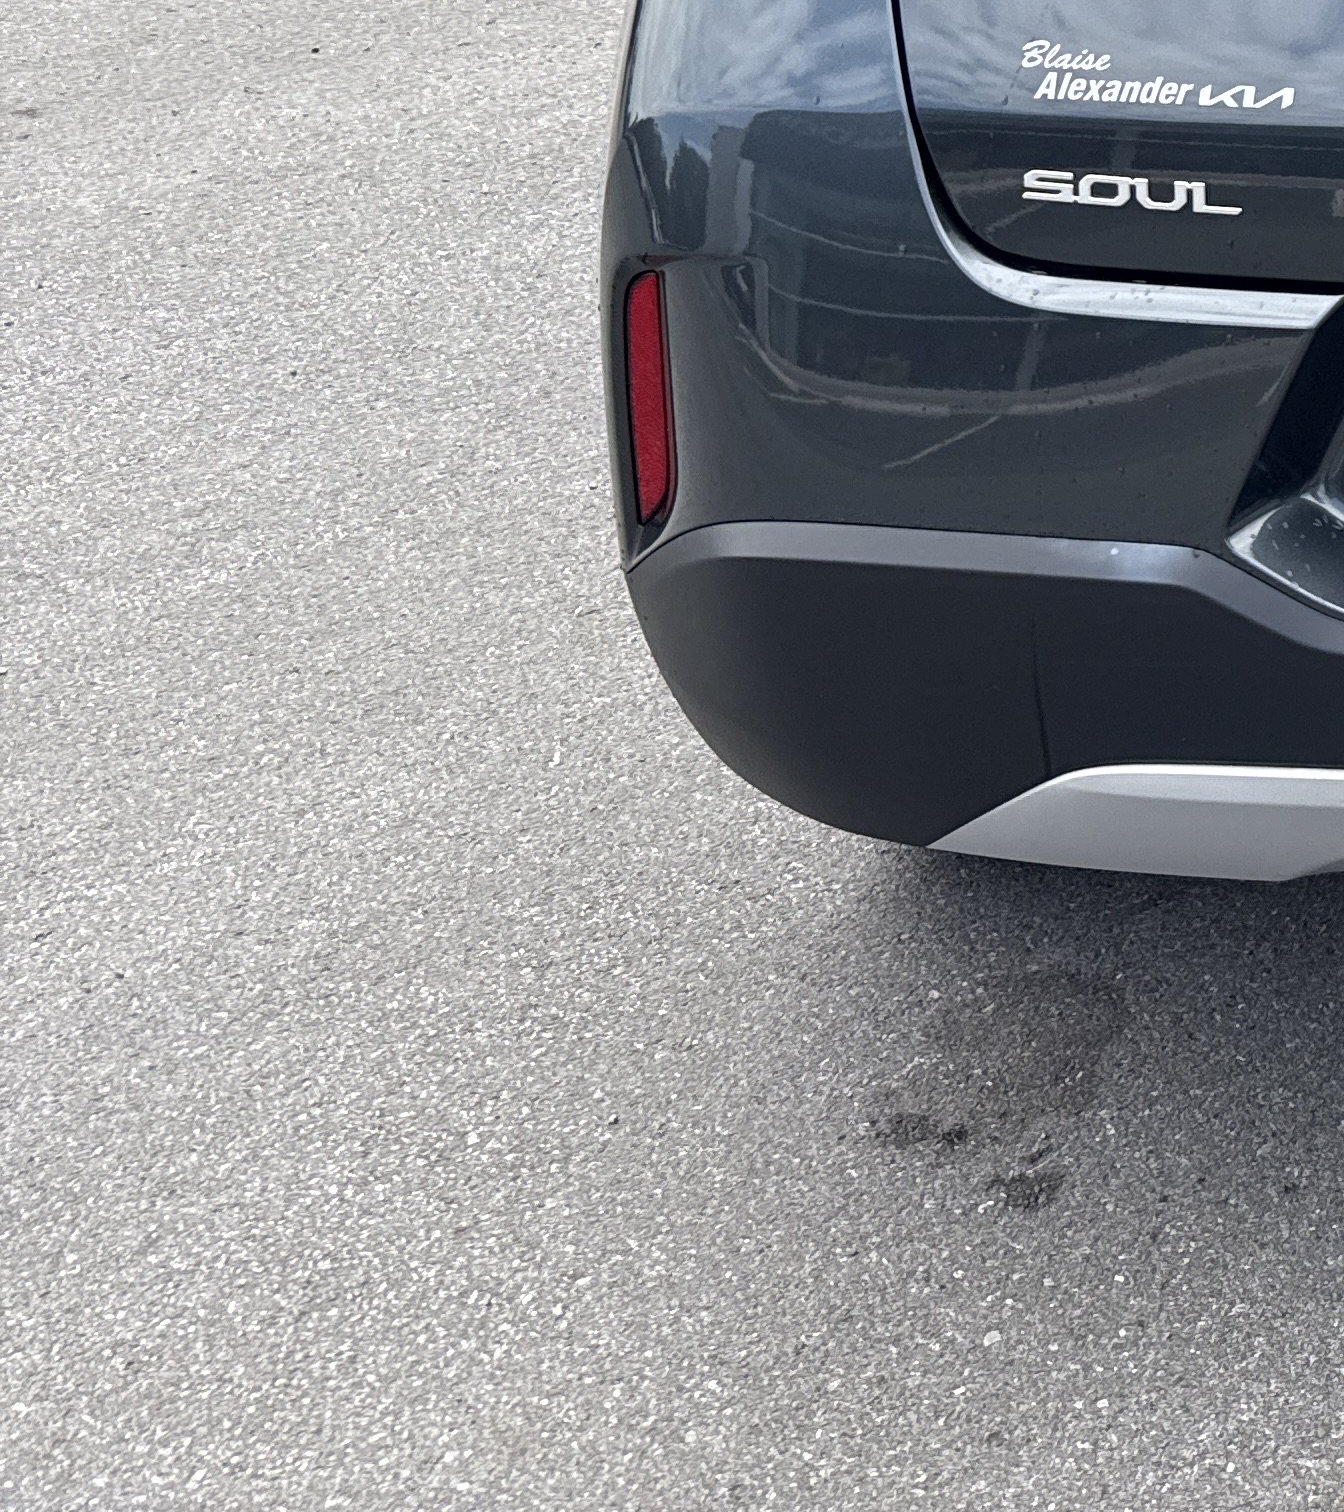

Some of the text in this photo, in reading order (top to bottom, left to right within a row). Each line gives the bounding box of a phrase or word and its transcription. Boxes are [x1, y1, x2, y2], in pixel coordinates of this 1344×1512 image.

[1021, 39, 1112, 71] Blaise
[1033, 71, 1295, 110] Alexander KIA
[1021, 168, 1243, 216] SOUL
